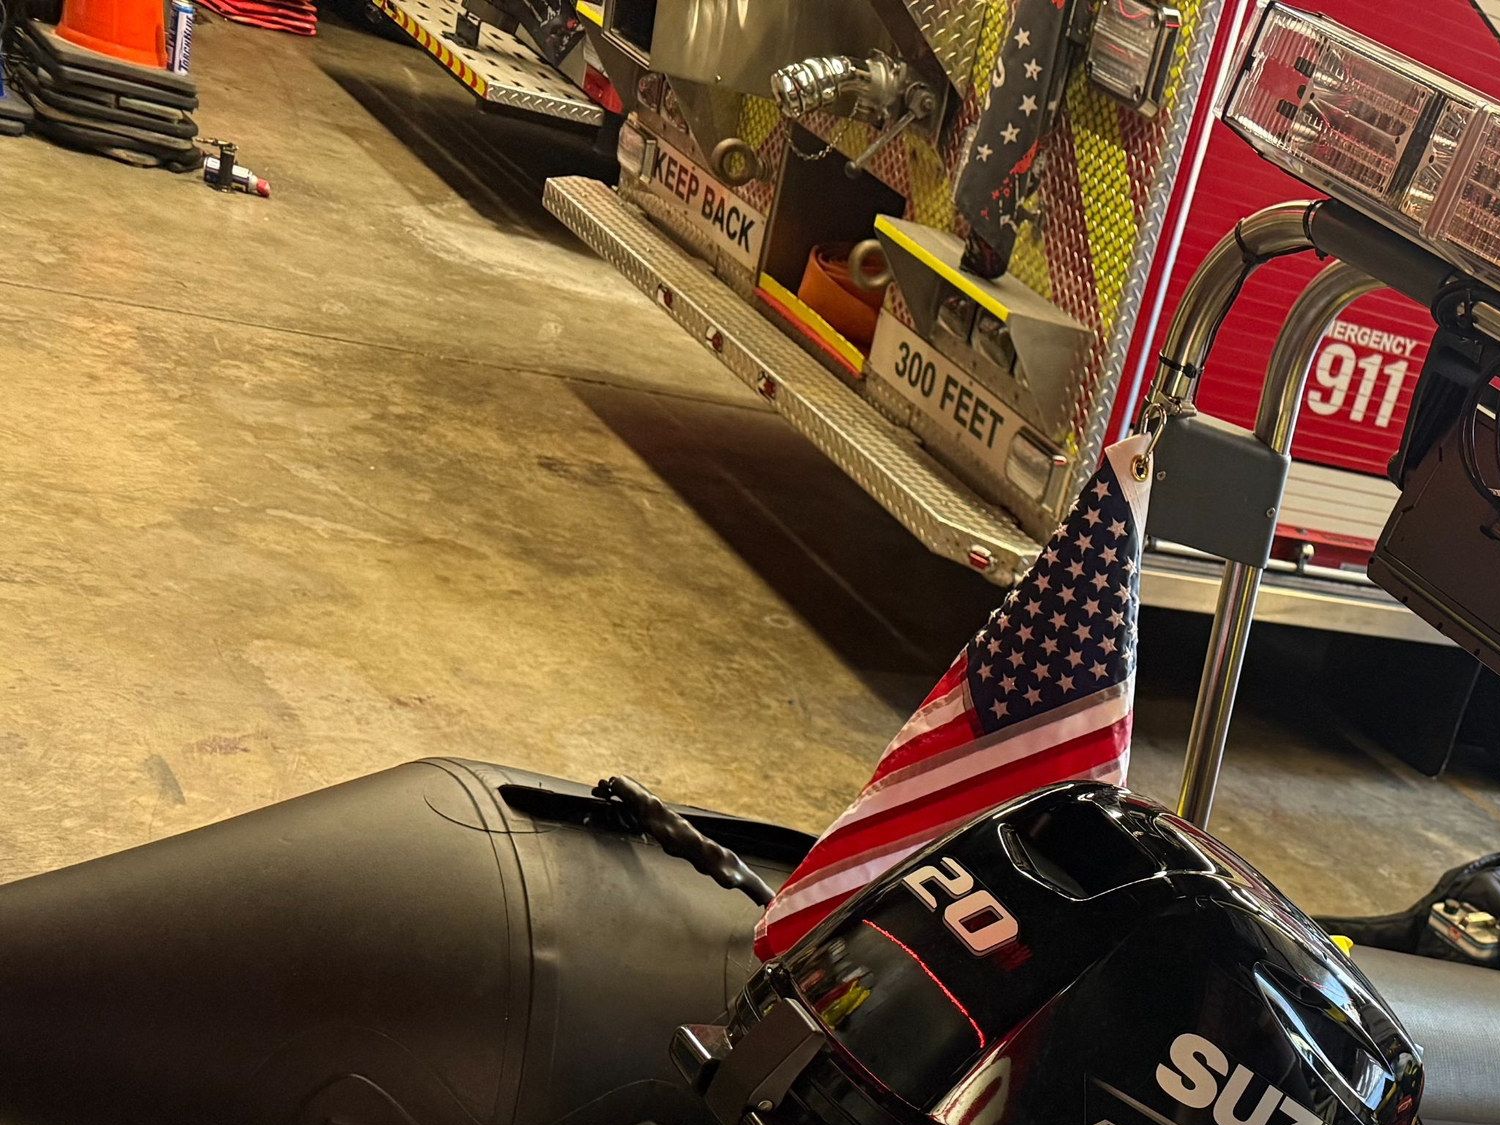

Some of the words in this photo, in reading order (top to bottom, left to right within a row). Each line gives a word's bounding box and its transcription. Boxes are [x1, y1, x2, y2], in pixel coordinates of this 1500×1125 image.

[653, 147, 700, 205] KEEP
[701, 185, 756, 253] BACK
[895, 341, 936, 398] 300
[939, 374, 1004, 449] FEET
[1307, 343, 1408, 428] 911
[902, 856, 1019, 957] 20
